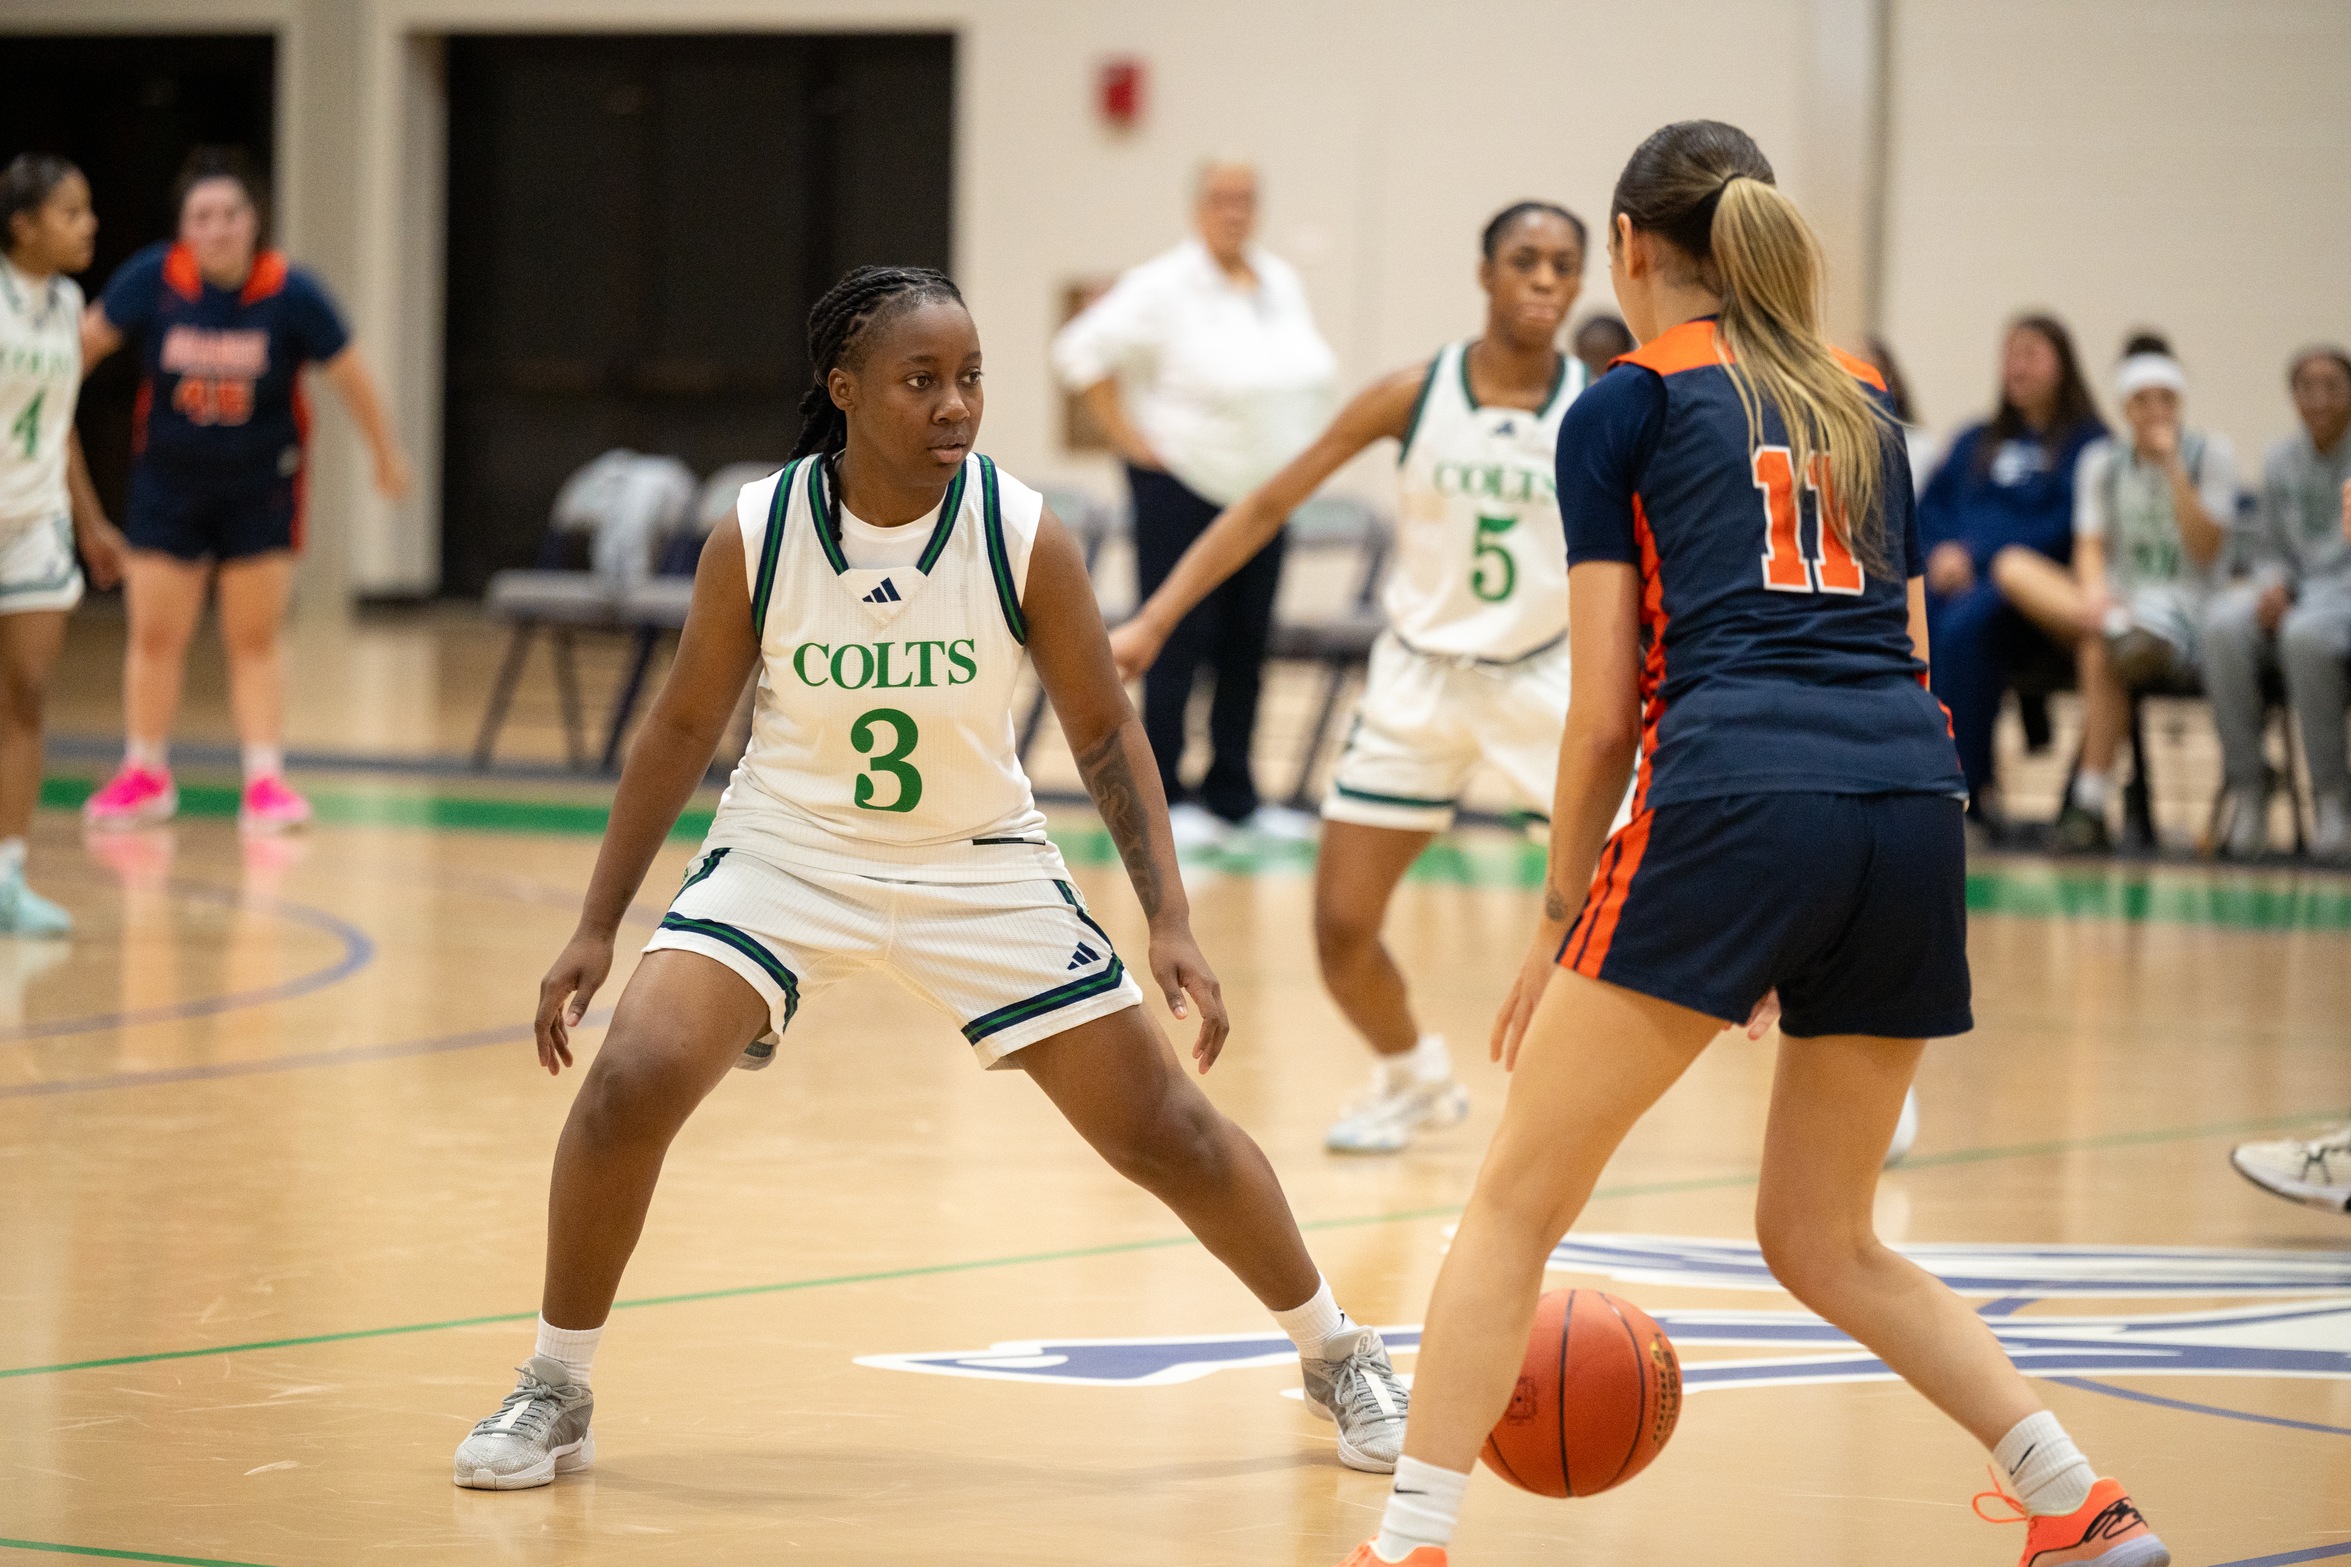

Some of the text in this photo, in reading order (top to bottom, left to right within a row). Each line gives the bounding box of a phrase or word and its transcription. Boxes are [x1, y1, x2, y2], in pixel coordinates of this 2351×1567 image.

[1471, 515, 1518, 603] 5
[1752, 445, 1865, 596] 11
[793, 638, 977, 690] COLTS
[850, 708, 923, 813] 3
